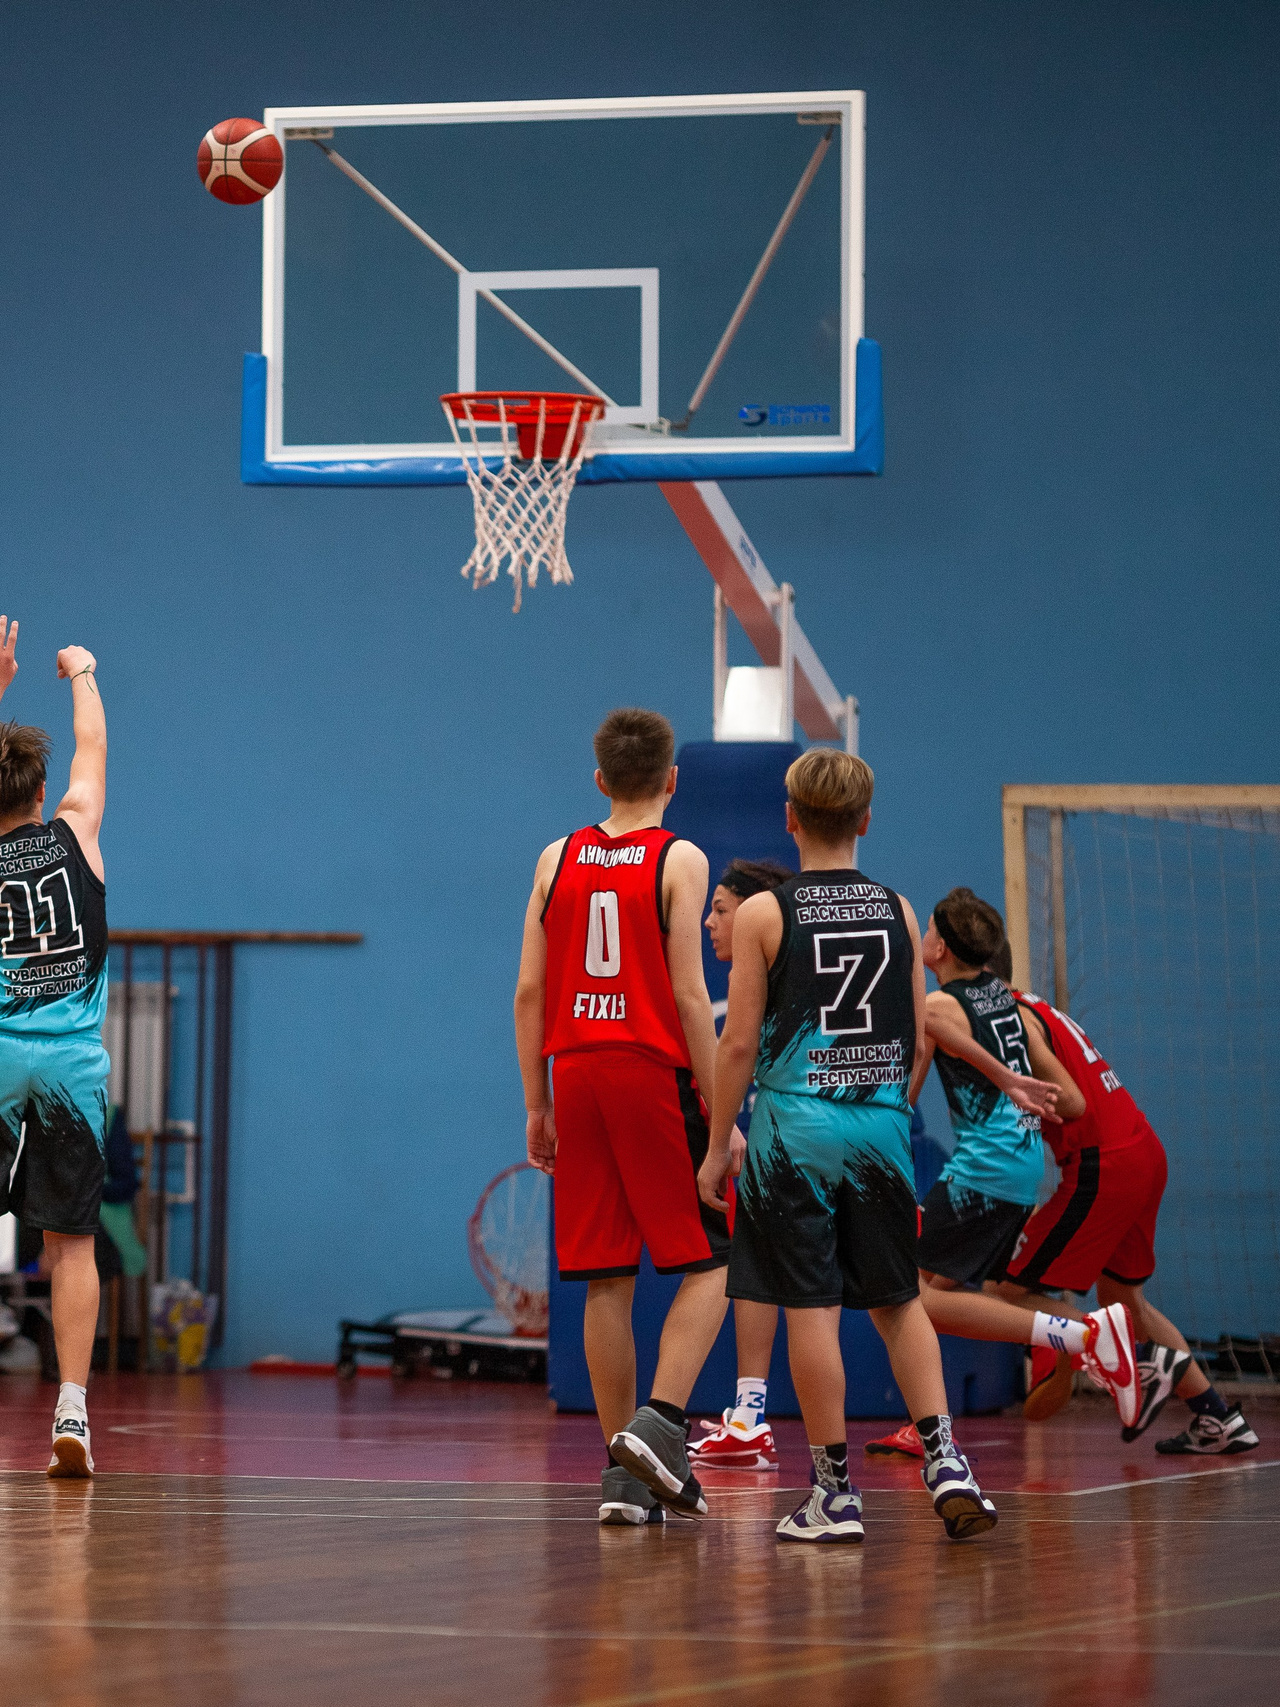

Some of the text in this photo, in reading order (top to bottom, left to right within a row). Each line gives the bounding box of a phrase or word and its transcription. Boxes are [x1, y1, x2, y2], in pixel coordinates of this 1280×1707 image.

[795, 884, 887, 902] ФЕДЕРАЦИЯ
[797, 903, 894, 924] БАСКЕТБОЛА
[585, 890, 621, 978] 0
[3, 956, 87, 983] ЧУВАШСКОЙ
[3, 977, 87, 998] РЕСПУБЛИКИ
[813, 930, 890, 1035] 7
[808, 1039, 902, 1065] ЧУВАШСКОЙ
[807, 1067, 904, 1087] РЕСПУБЛИКИ
